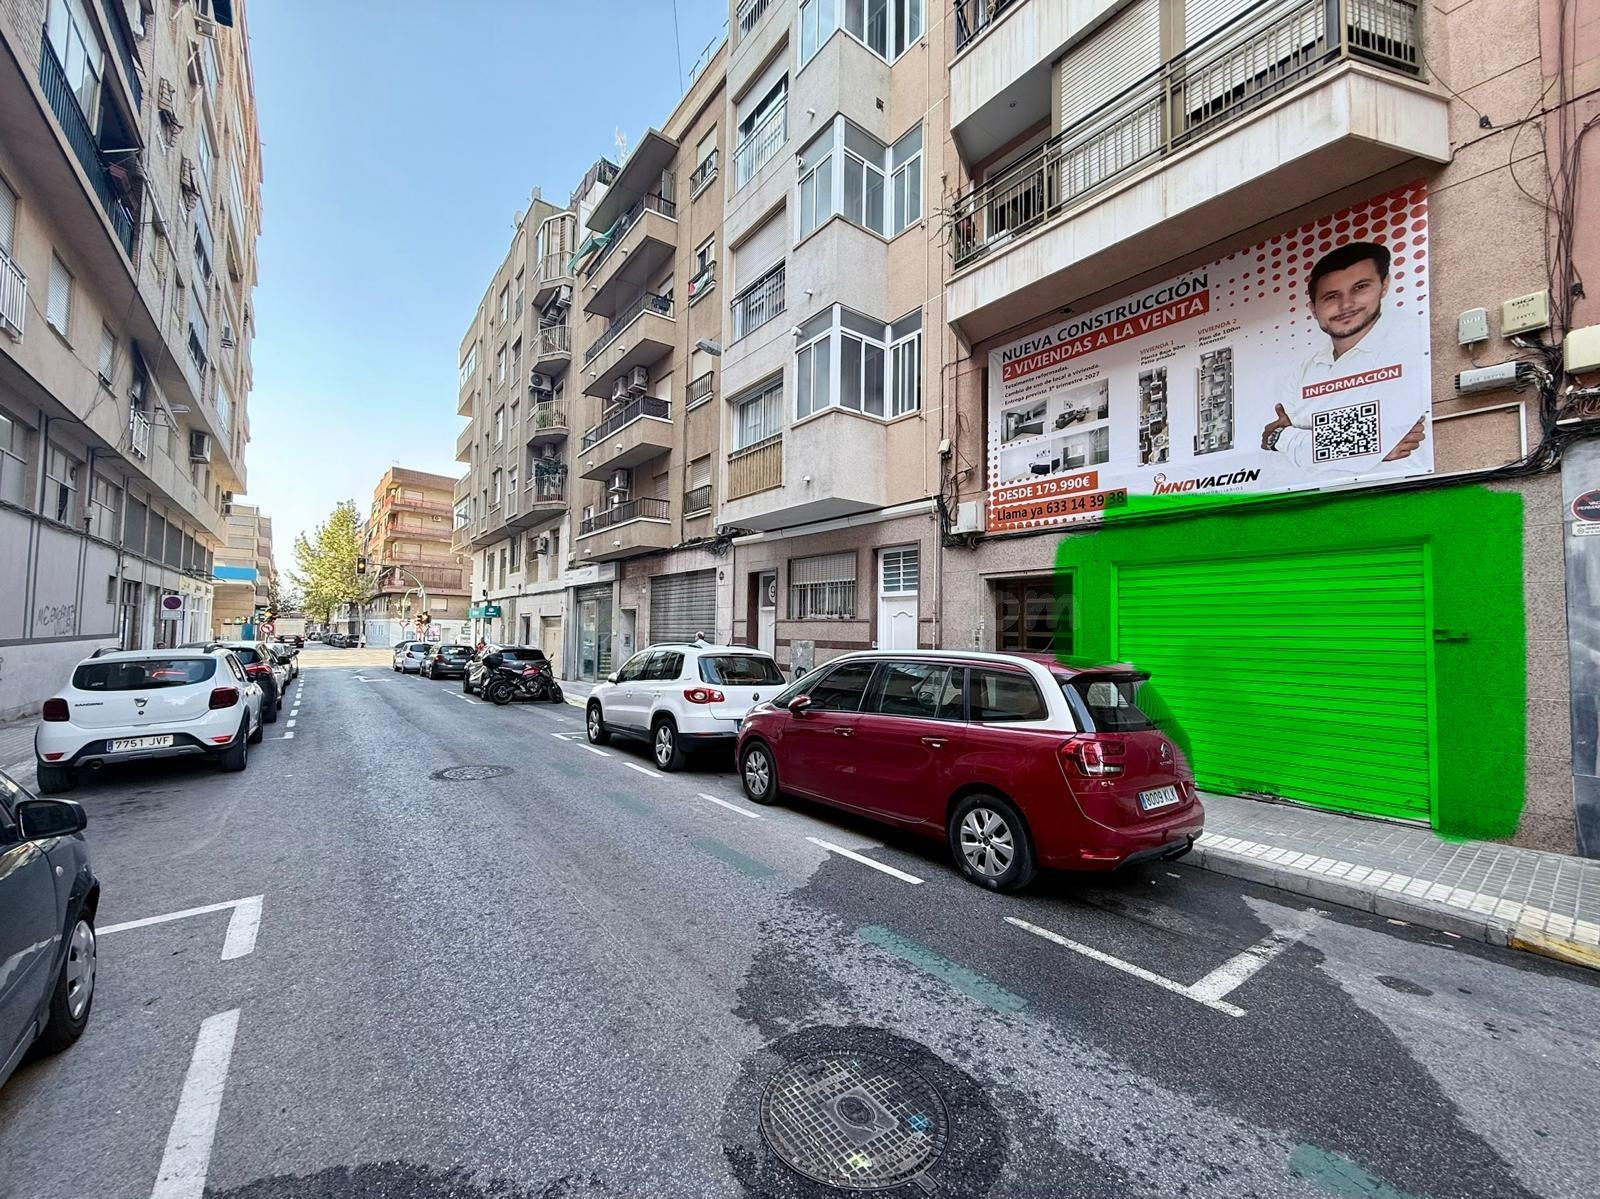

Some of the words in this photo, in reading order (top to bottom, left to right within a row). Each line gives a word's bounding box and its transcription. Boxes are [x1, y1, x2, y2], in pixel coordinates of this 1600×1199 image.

[1002, 334, 1053, 363] NUEVA
[1057, 273, 1208, 342] CONSTRUCCIÓN
[1197, 320, 1231, 335] VIVIENDA
[1003, 366, 1012, 379] 2
[1014, 336, 1093, 375] VIVIENDAS
[1096, 331, 1109, 347] A
[1113, 322, 1135, 341] LA
[1138, 297, 1204, 331] VENTA
[1139, 341, 1169, 355] VIVIENDA
[1004, 377, 1035, 390] Totalmente
[1004, 388, 1025, 398] Cambio
[1052, 374, 1067, 382] local
[1305, 367, 1400, 397] INFORMACIÓN
[1004, 396, 1025, 406] Entrega
[1025, 389, 1048, 400] prevista
[998, 487, 1033, 502] DESDE
[1036, 475, 1091, 496] 179.990€
[997, 508, 1028, 521] Llama
[1030, 505, 1043, 519] ya
[1046, 499, 1067, 514] 633
[1071, 497, 1086, 510] 14
[1089, 494, 1105, 507] 39
[114, 739, 144, 750] 7751
[149, 736, 171, 746] JVF
[1144, 790, 1164, 807] 8009
